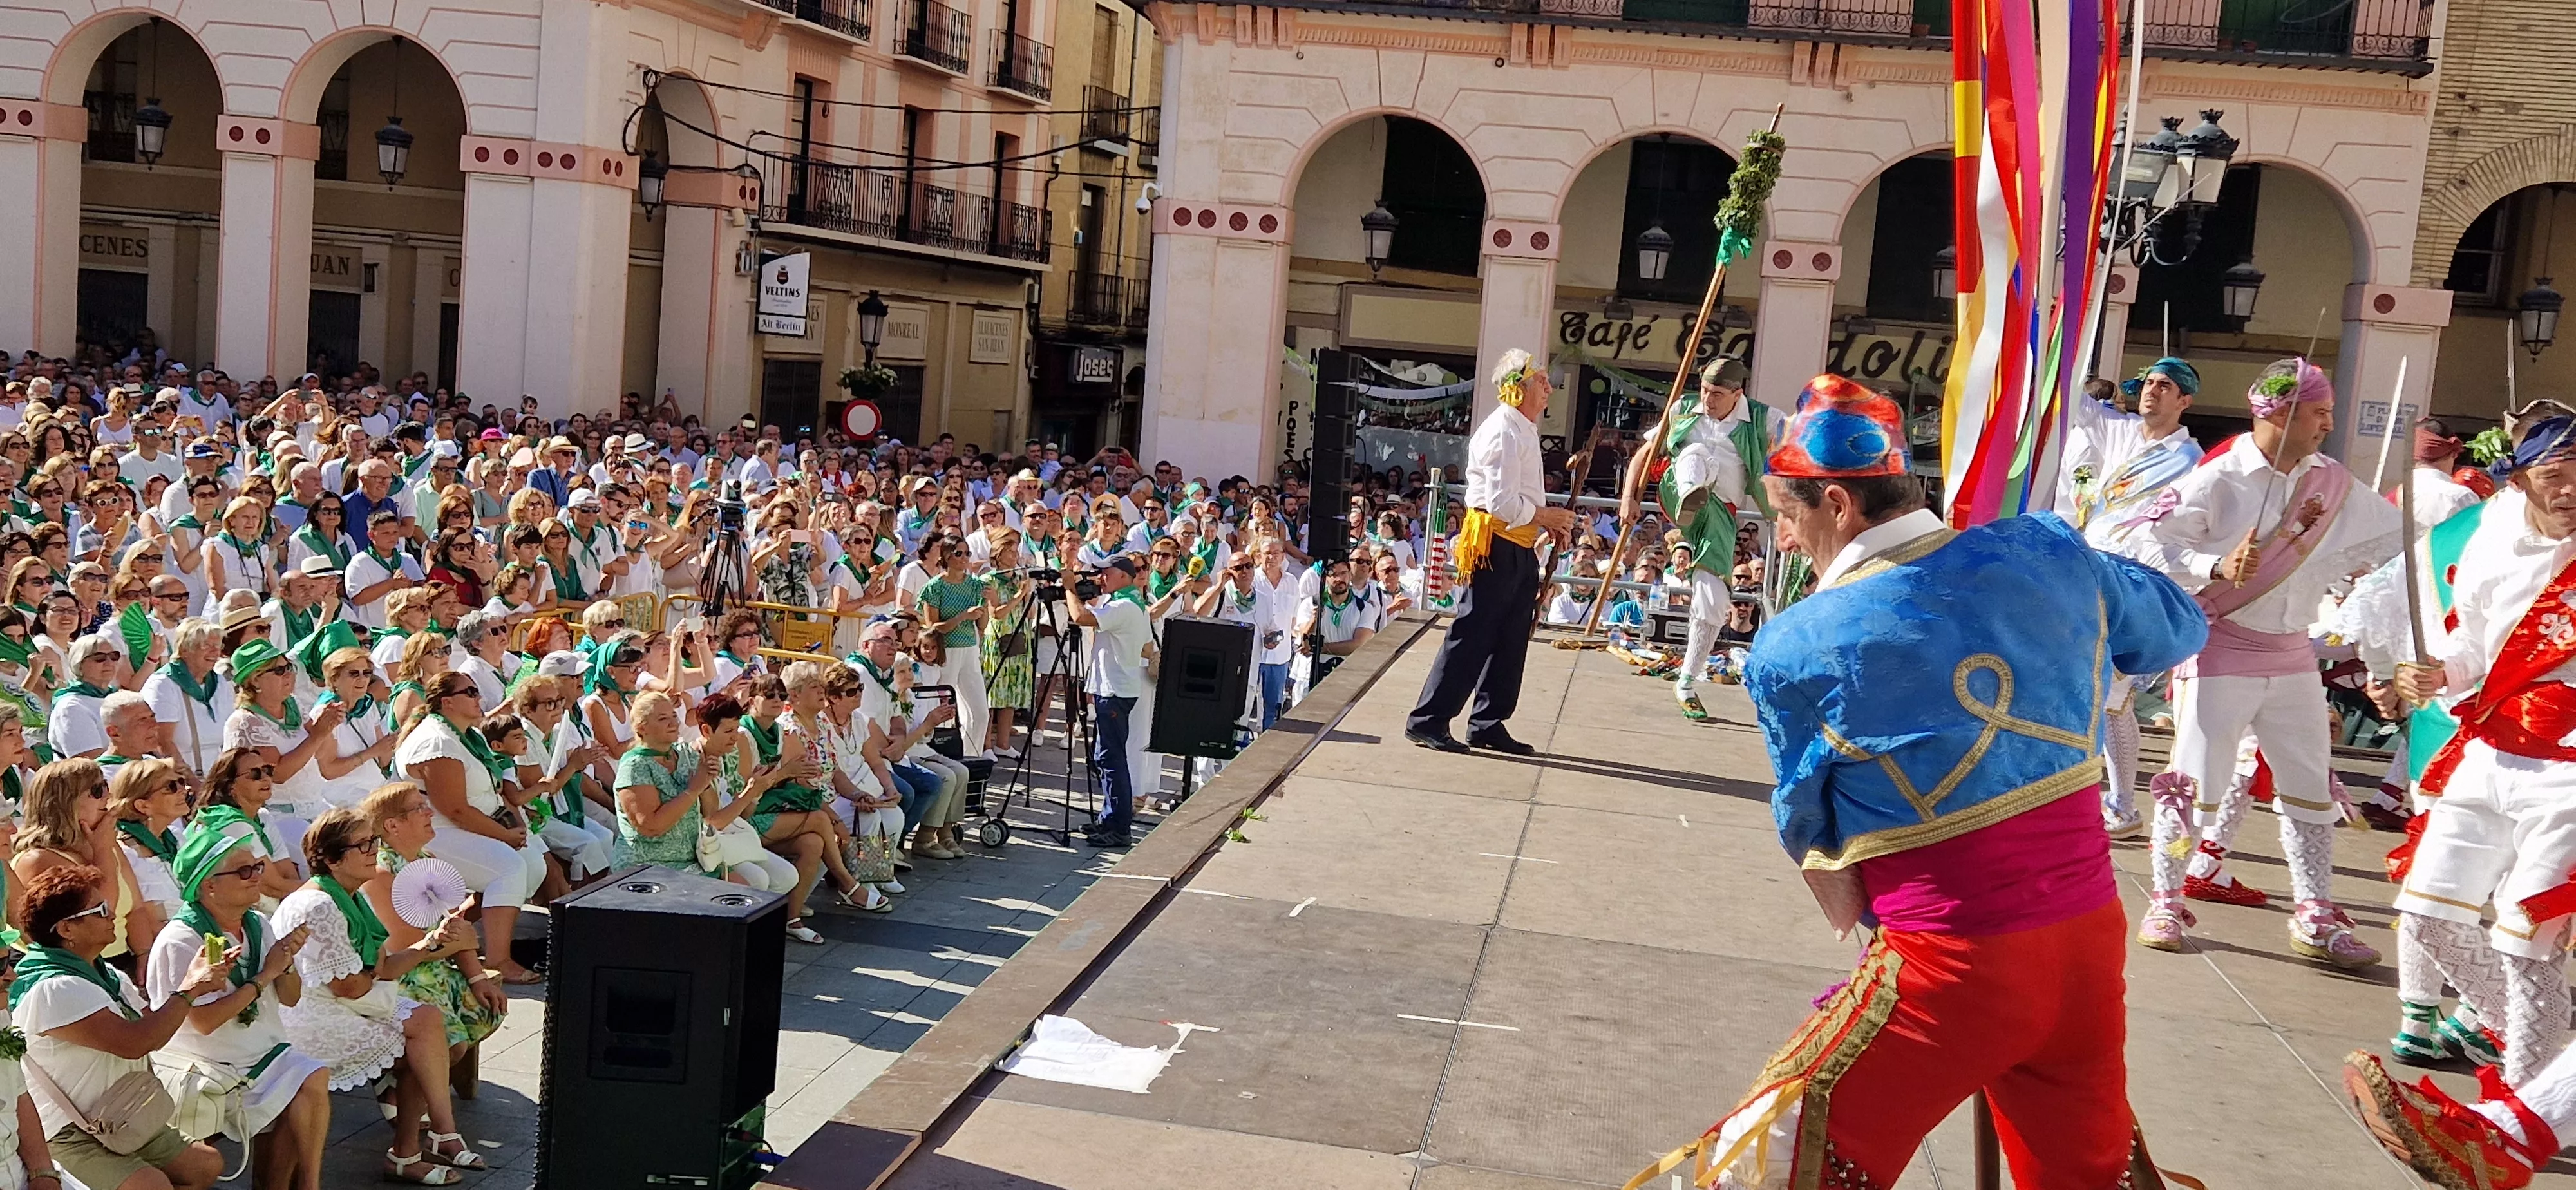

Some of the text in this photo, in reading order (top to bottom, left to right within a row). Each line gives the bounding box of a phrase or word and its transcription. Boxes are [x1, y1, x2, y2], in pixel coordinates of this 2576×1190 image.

[765, 285, 800, 298] VELTINS
[761, 319, 800, 331] Alt Berlin
[1560, 311, 1660, 360] Café
